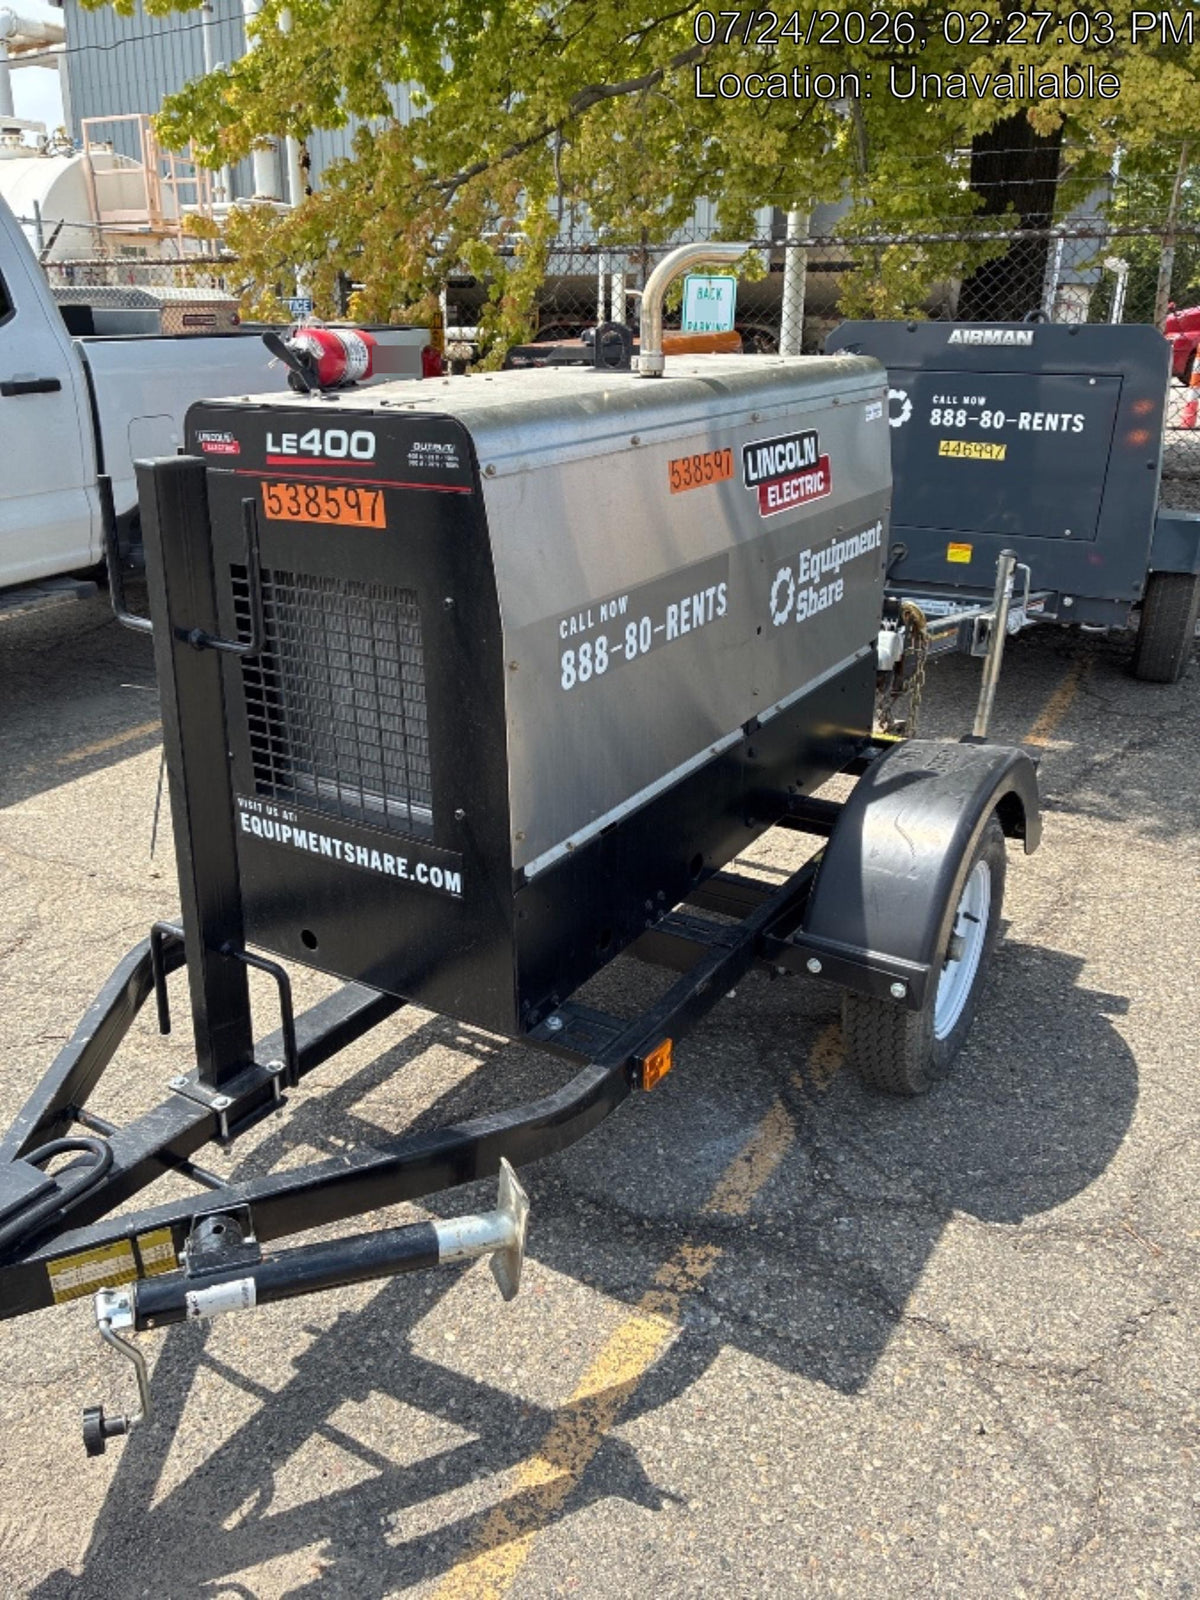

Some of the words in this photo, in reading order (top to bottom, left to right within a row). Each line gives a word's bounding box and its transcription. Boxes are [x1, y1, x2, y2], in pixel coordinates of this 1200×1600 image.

[697, 287, 723, 301] BACK
[948, 329, 1036, 346] AIRMAN
[932, 395, 958, 405] CALL
[963, 396, 987, 406] NOW
[930, 408, 1085, 433] 888-80-RENTS
[266, 428, 376, 460] LE400
[746, 436, 817, 481] LINCOLN
[941, 441, 1004, 459] 446997
[671, 447, 732, 489] 538597
[266, 484, 378, 522] 538597
[767, 470, 825, 508] ELECTRIC
[798, 520, 883, 584] Equipment
[559, 610, 595, 640] CALL
[600, 595, 629, 622] NOW
[796, 578, 844, 623] Share
[561, 582, 728, 691] 888-80-RENTS
[237, 798, 262, 813] VISIT
[266, 804, 279, 817] US
[240, 812, 462, 894] EQUIPMENTSHARE.COM
